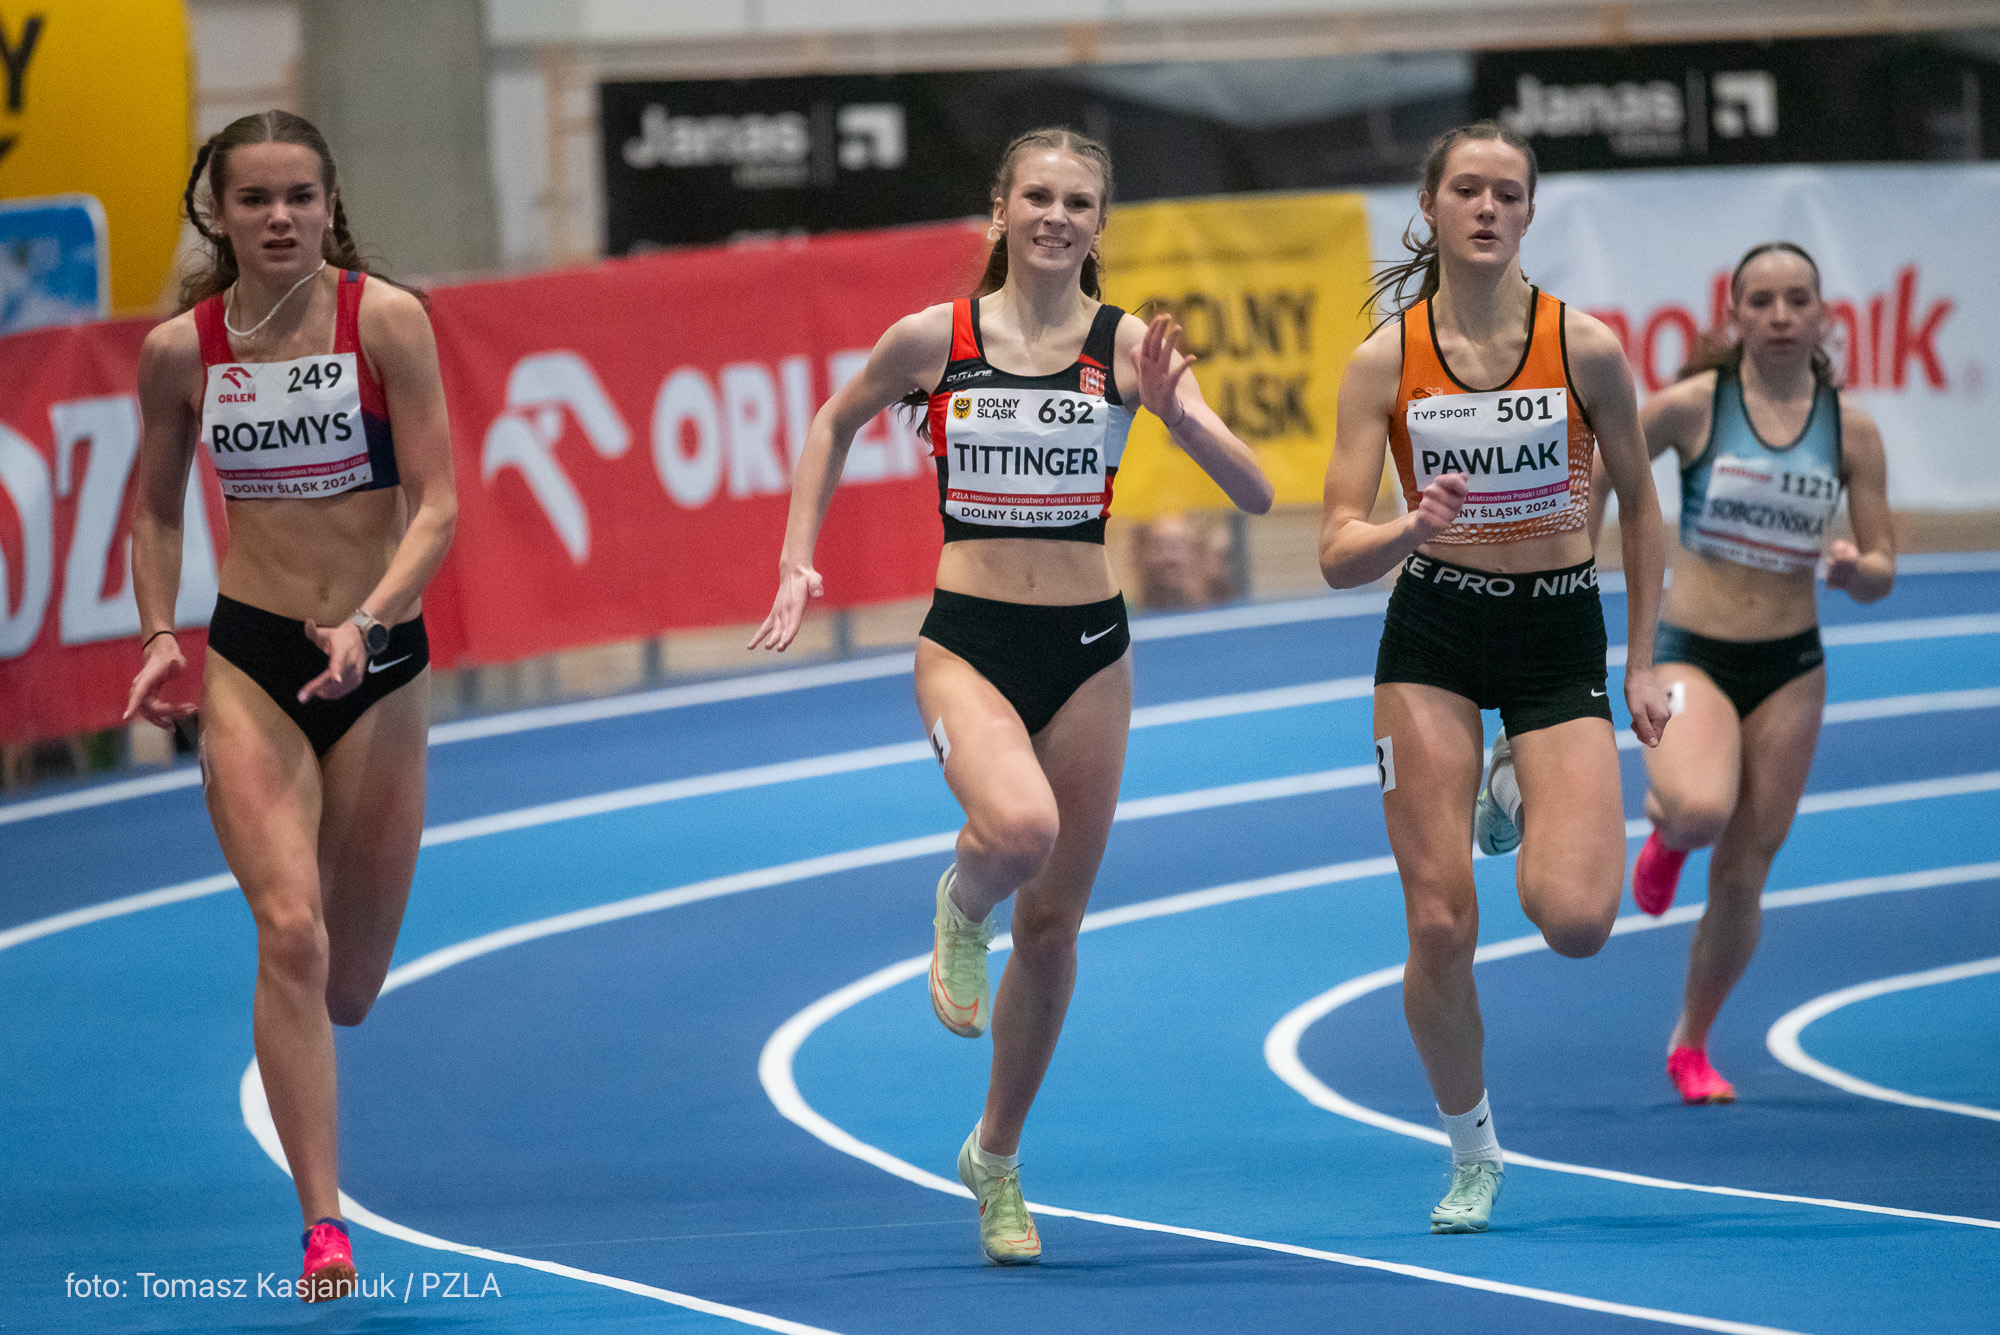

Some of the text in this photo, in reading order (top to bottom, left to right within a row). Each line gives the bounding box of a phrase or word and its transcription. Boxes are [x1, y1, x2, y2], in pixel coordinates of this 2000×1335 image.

[287, 362, 342, 393] 249
[218, 393, 256, 404] ORLEN
[977, 398, 1020, 408] DOLNY
[1497, 396, 1552, 422] 501
[976, 408, 1017, 420] ŚLĄSK
[1038, 399, 1094, 424] 632
[1414, 408, 1477, 421] TVP SPORT
[212, 412, 353, 453] ROZMYS
[954, 443, 1098, 476] TITTINGER
[1422, 440, 1560, 476] PAWLAK
[262, 469, 307, 478] Mistrzostwa
[308, 466, 331, 474] Polski
[232, 473, 356, 495] DOLNY ŚLĄSK 2024
[1468, 493, 1512, 502] Mistrzostwa
[1513, 491, 1535, 500] Polski
[1536, 488, 1548, 496] U18
[1554, 483, 1567, 492] U20
[1780, 472, 1834, 500] 1121
[952, 491, 969, 500] PZLA
[970, 494, 997, 502] Halowe
[998, 496, 1045, 504] Mistrzostwa
[1086, 495, 1100, 503] U20
[961, 507, 1089, 523] DOLNY ŚLĄSK 2024
[1480, 506, 1521, 519] ŚLĄSK
[1526, 499, 1557, 514] 2024
[1433, 568, 1515, 597] PRO
[1532, 564, 1598, 598] NIKE
